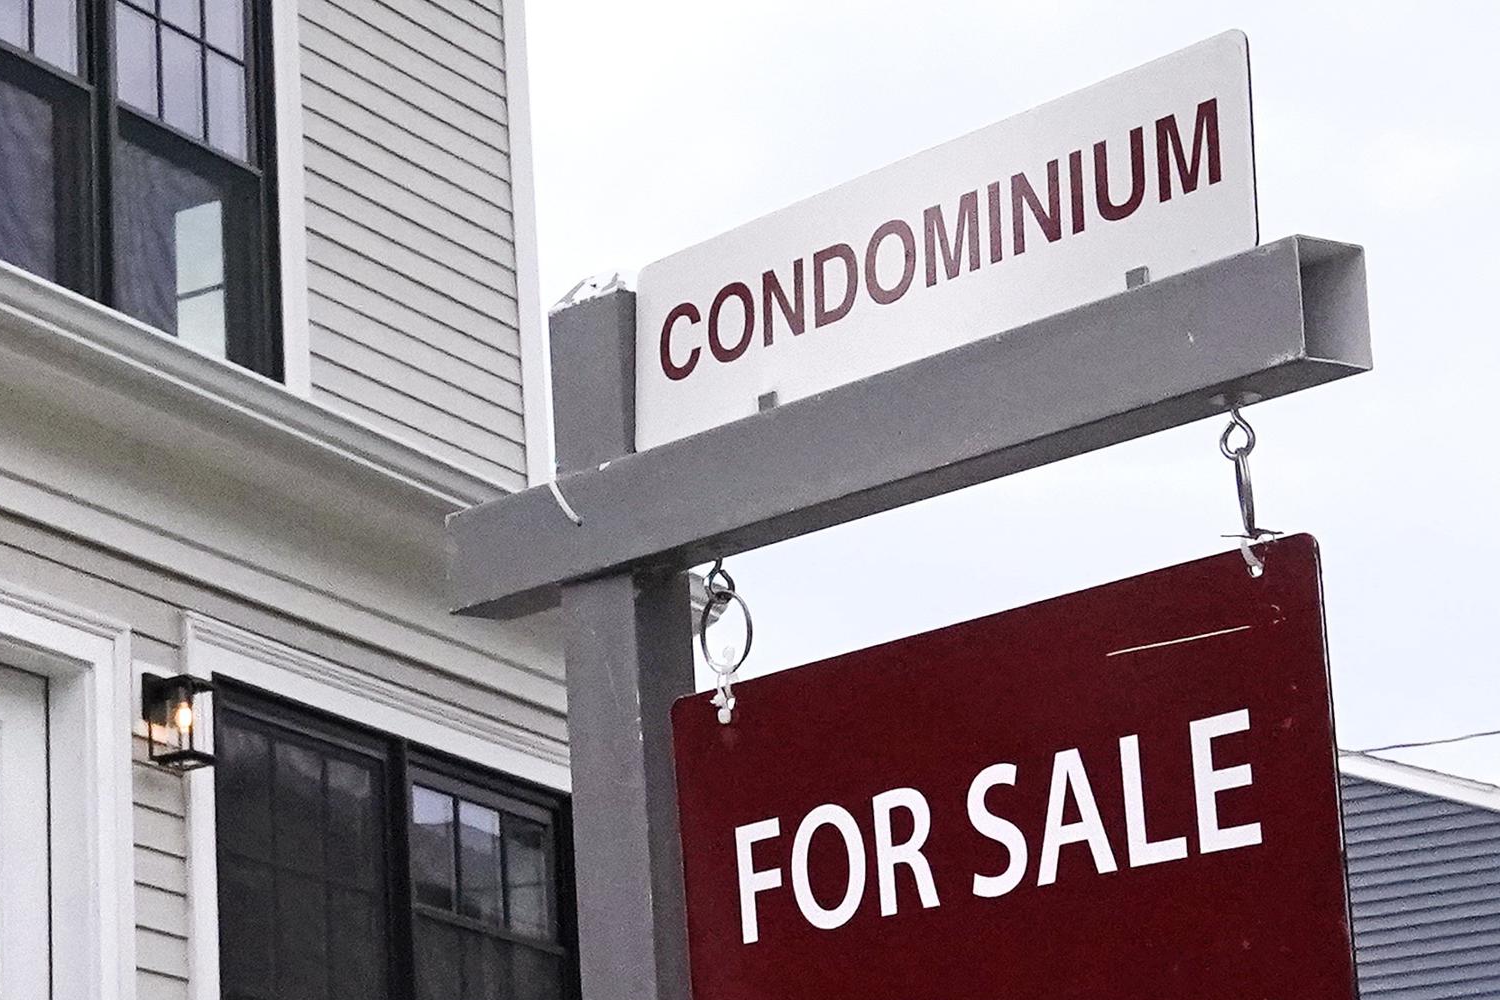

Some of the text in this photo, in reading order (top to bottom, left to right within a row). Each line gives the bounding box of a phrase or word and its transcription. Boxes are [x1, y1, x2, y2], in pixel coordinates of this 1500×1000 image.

[659, 97, 1222, 381] CONDOMINIUM
[734, 708, 1263, 945] FOR SALE
